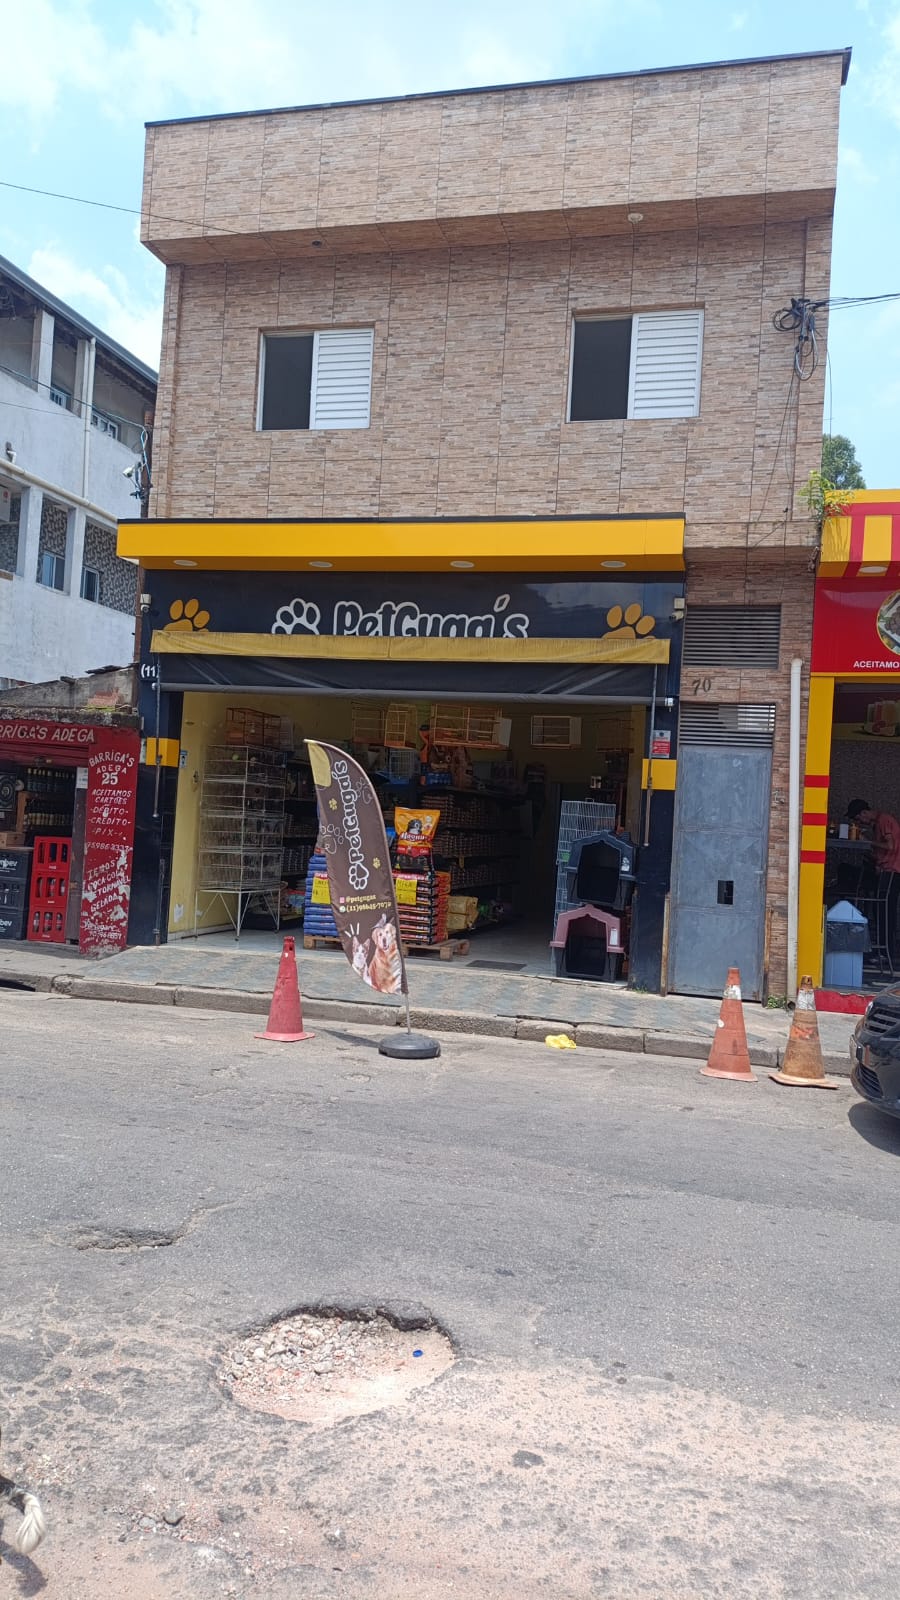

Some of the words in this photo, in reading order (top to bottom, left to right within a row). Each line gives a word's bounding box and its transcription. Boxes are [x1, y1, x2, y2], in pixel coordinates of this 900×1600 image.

[692, 677, 711, 696] 70
[51, 728, 95, 743] ADEGA
[88, 749, 135, 768] BARRIGA'S
[96, 764, 127, 775] ADEGA
[101, 772, 119, 786] 25
[92, 788, 132, 798] ACEITAMOS
